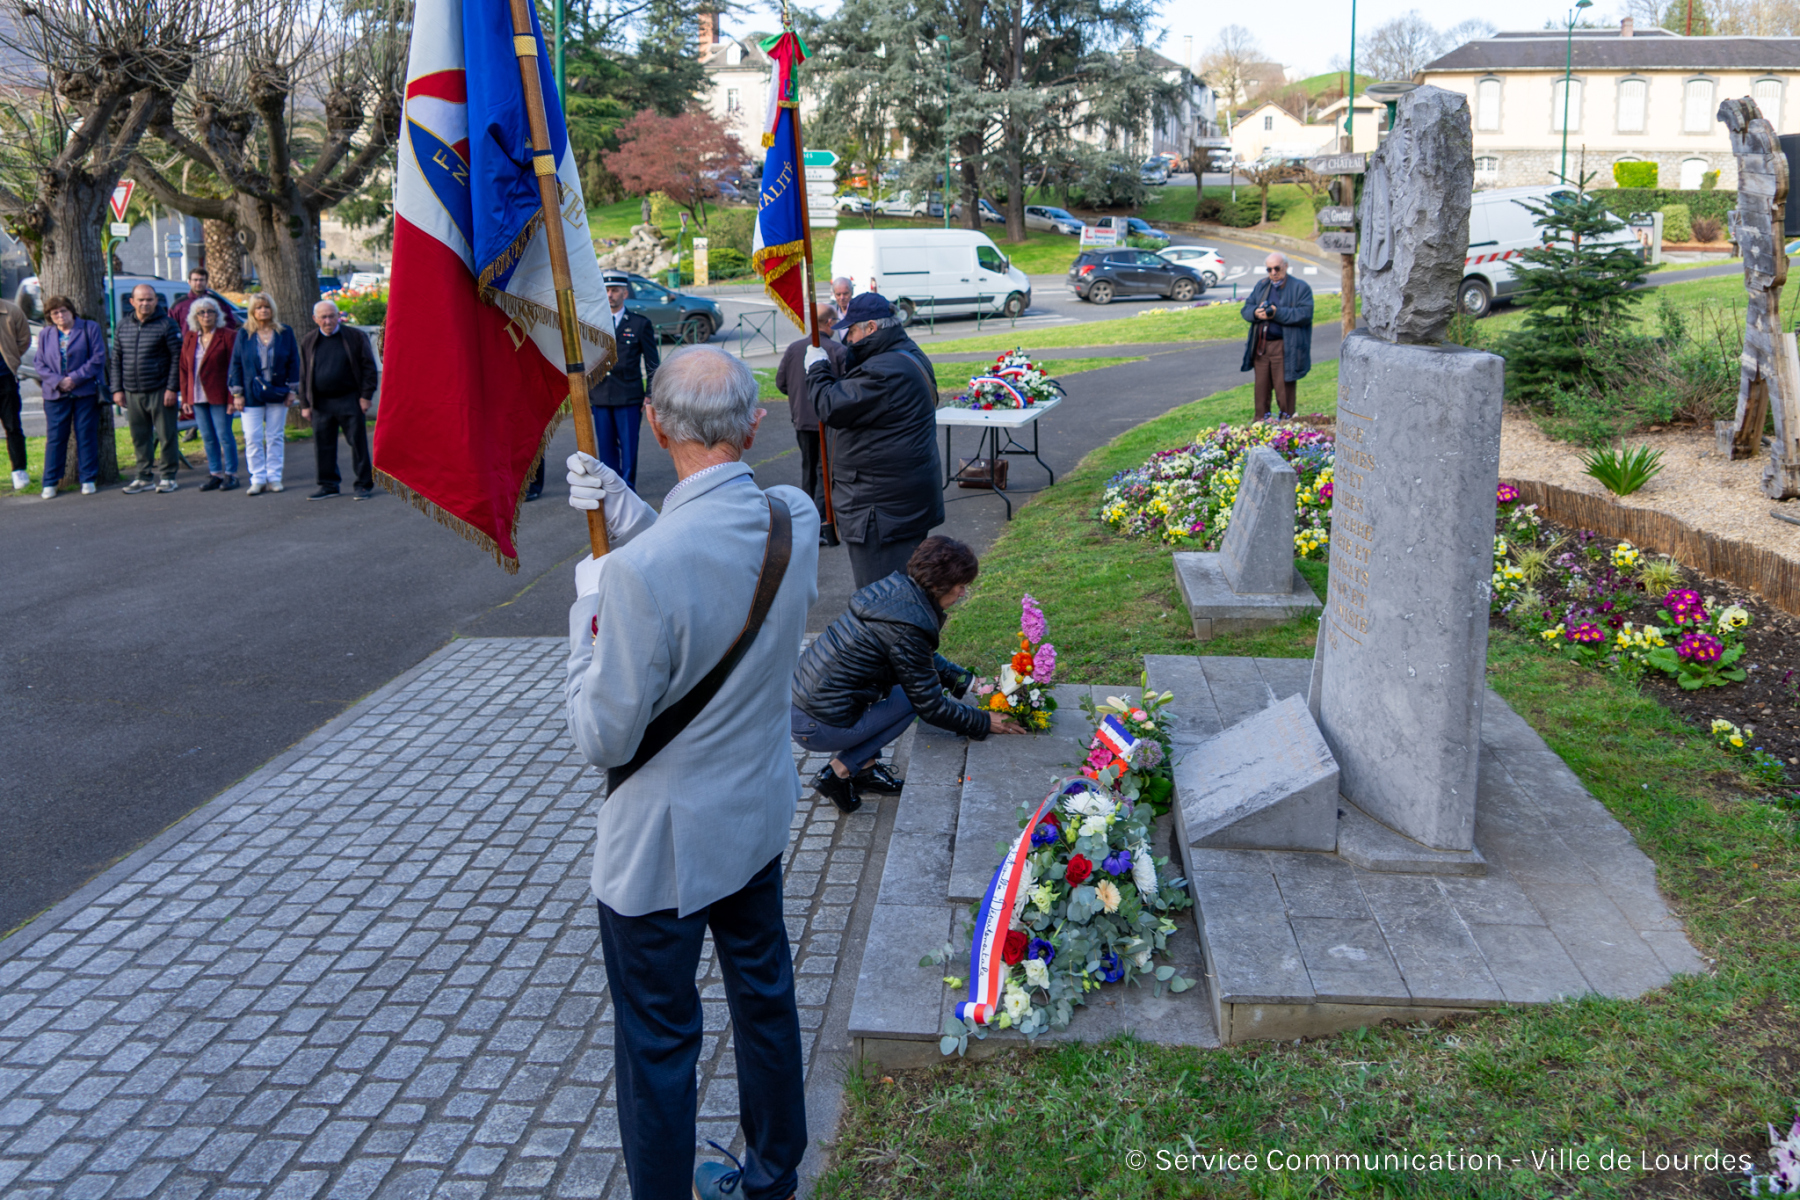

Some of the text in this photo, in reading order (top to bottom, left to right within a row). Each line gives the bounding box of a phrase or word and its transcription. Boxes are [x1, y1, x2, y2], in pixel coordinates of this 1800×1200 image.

[1328, 156, 1364, 169] CHÂTEAU
[1331, 209, 1352, 222] Grotte
[1349, 471, 1364, 490] ET
[1355, 543, 1371, 564] ET
[1351, 588, 1367, 609] ET
